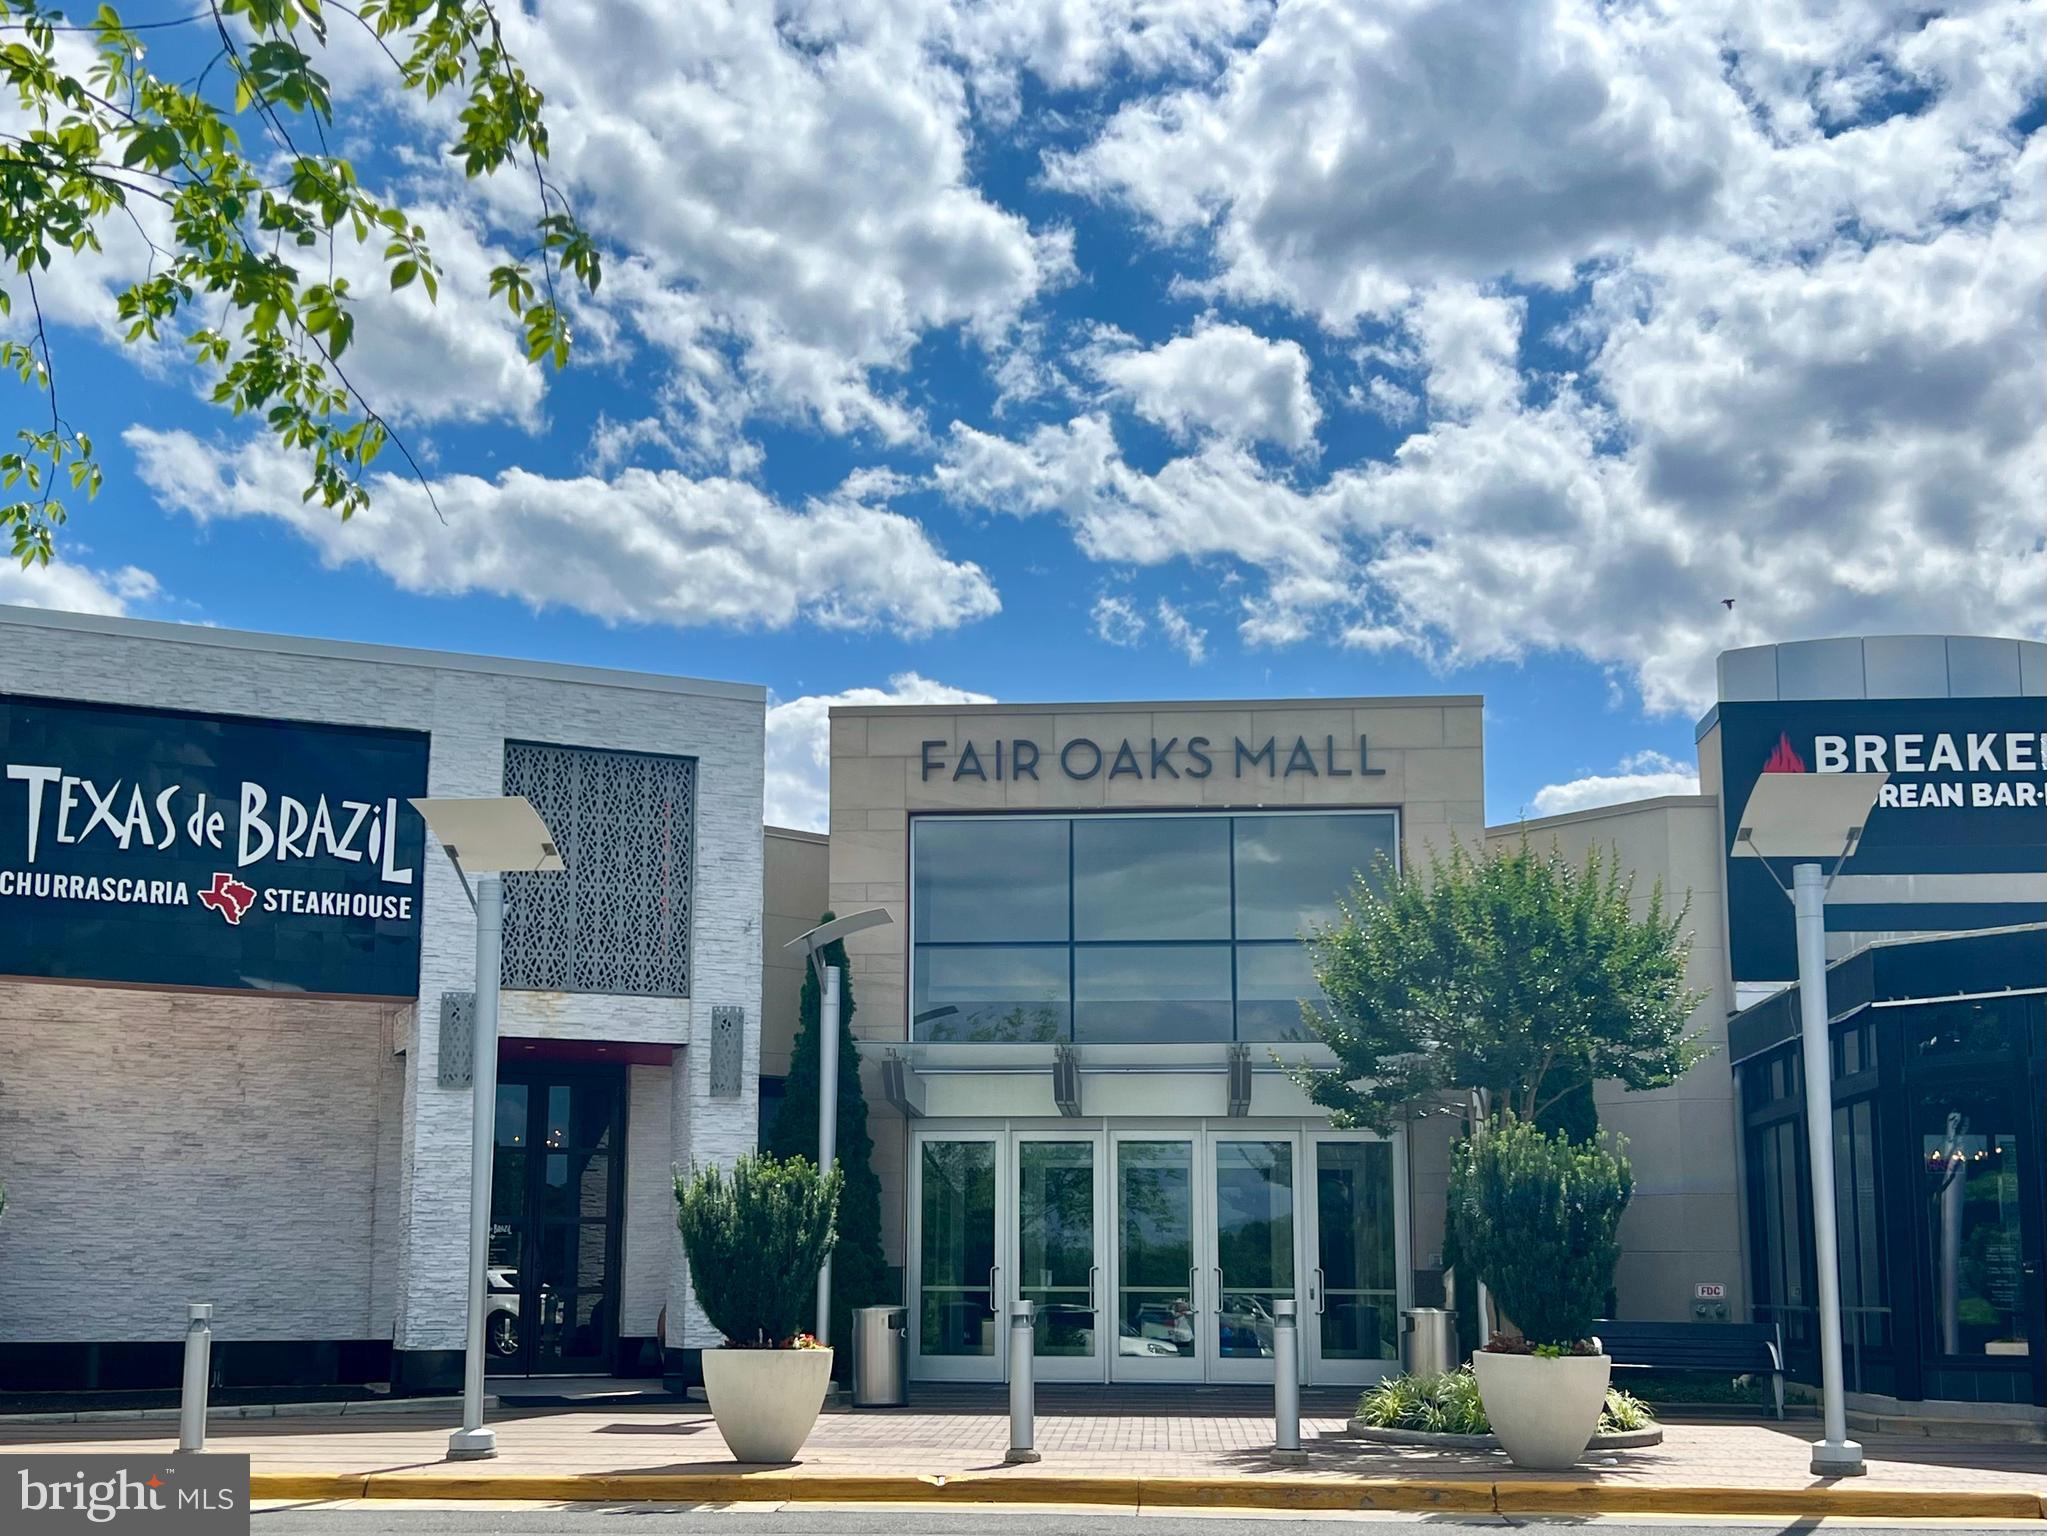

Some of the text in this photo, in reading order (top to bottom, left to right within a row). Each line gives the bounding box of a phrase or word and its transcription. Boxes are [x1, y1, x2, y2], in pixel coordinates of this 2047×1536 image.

[921, 734, 1386, 781] FAIR OAKS MALL
[1814, 732, 2047, 774] BREAKE
[7, 764, 181, 864] TEXAS
[187, 793, 225, 850] de
[1873, 783, 1964, 808] REAN
[0, 870, 412, 920] CHURRASCARIA STEAKHOUSE
[1701, 1286, 1721, 1296] FDC
